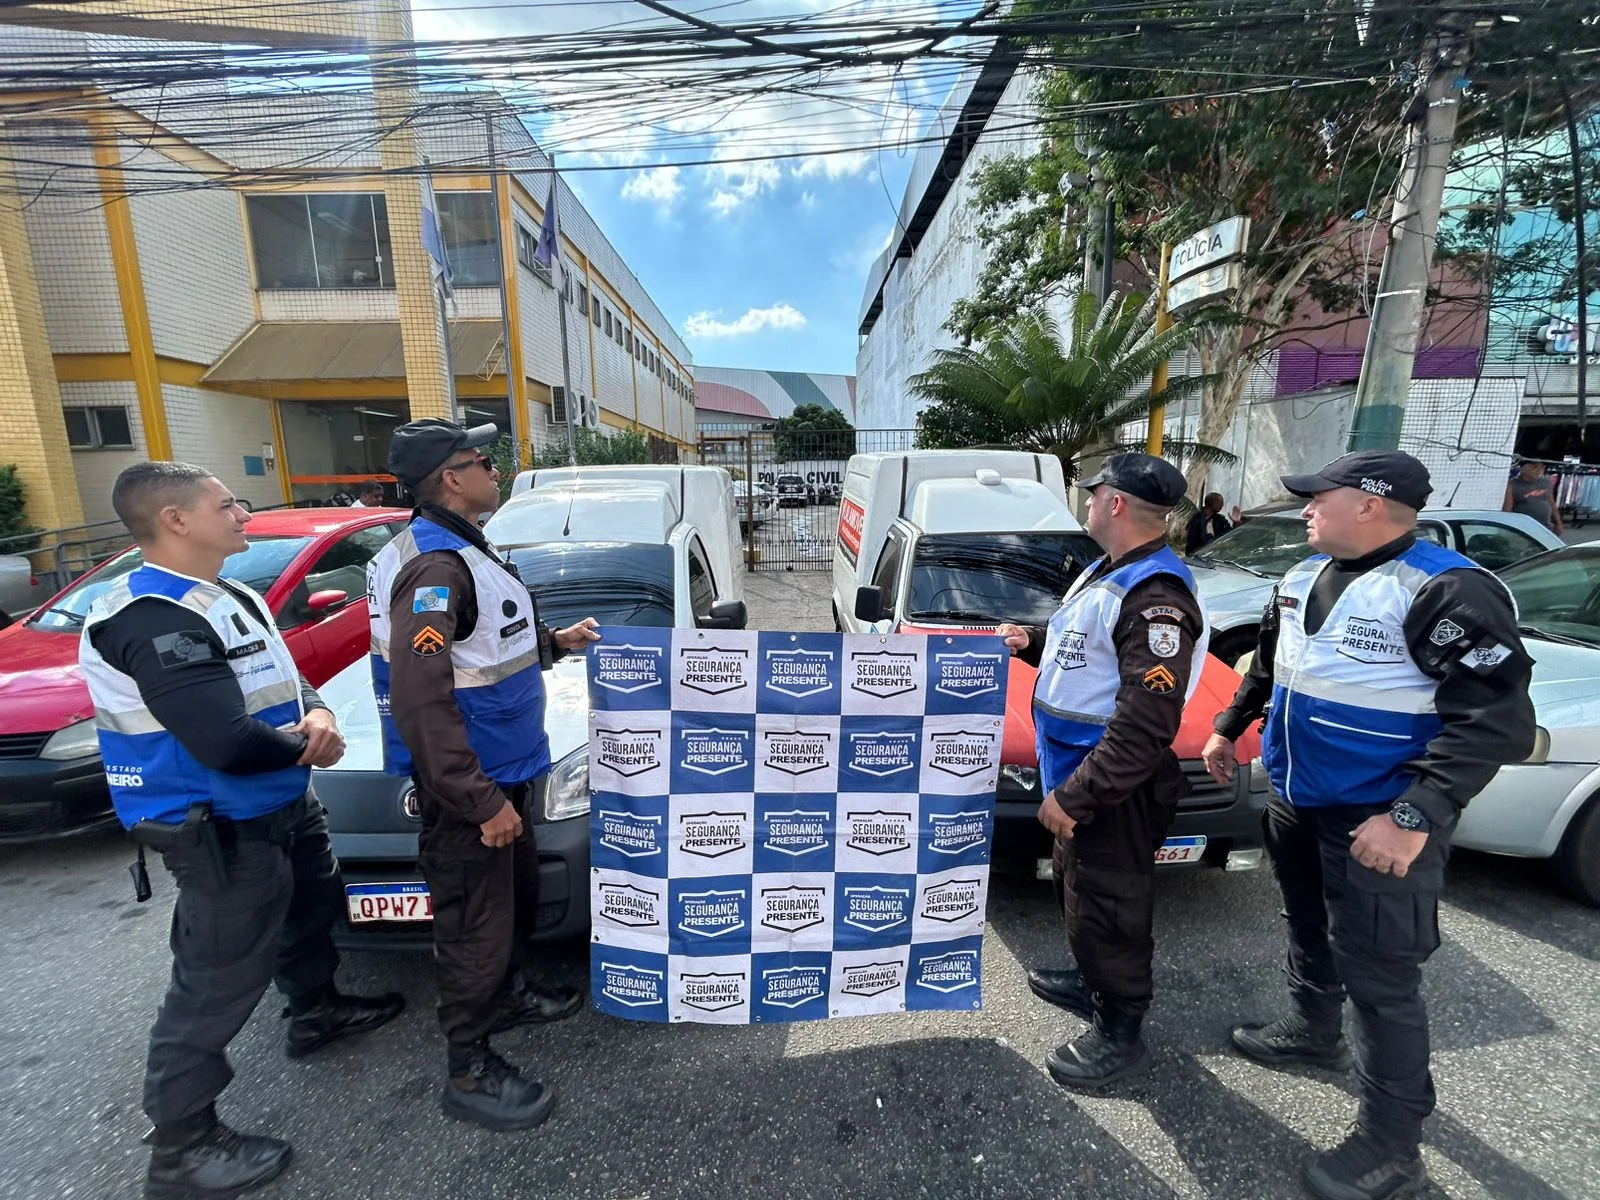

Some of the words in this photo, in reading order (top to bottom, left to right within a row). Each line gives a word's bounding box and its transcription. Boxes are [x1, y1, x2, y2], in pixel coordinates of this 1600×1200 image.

[806, 471, 842, 484] CIVIL
[1360, 477, 1392, 491] POLÍCIA
[1360, 483, 1386, 496] PENAL
[506, 624, 521, 634] COSTA
[1342, 636, 1404, 656] PRESENTE
[600, 658, 656, 672] SEGURANÇA
[686, 661, 742, 675] SEGURANÇA
[772, 663, 827, 677] SEGURANÇA
[857, 665, 912, 679] SEGURANÇA
[600, 672, 656, 681] PRESENTE
[686, 674, 742, 684] PRESENTE
[941, 666, 994, 680] SEGURANÇA
[772, 676, 827, 685] PRESENTE
[857, 678, 912, 686] PRESENTE
[941, 678, 994, 687] PRESENTE
[602, 741, 655, 756] SEGURANÇA
[688, 742, 742, 756] SEGURANÇA
[770, 743, 824, 758] SEGURANÇA
[856, 744, 908, 758] SEGURANÇA
[936, 744, 988, 758] SEGURANÇA
[603, 754, 655, 765] PRESENTE
[687, 755, 742, 763] PRESENTE
[770, 756, 824, 764] PRESENTE
[855, 757, 908, 765] PRESENTE
[935, 756, 987, 766] PRESENTE
[106, 772, 144, 787] NEIRO
[604, 823, 655, 841] SEGURANÇA
[686, 825, 740, 840] SEGURANÇA
[770, 823, 823, 837] SEGURANÇA
[852, 823, 906, 837] SEGURANÇA
[935, 822, 983, 838] SEGURANÇA
[605, 834, 655, 850] PRESENTE
[686, 838, 740, 847] PRESENTE
[770, 836, 823, 844] PRESENTE
[852, 836, 906, 845] PRESENTE
[934, 834, 983, 847] PRESENTE
[1155, 848, 1190, 860] G61
[604, 894, 654, 913] SEGURANÇA
[927, 891, 974, 906] SEGURANÇA
[684, 903, 739, 917] SEGURANÇA
[766, 899, 819, 913] SEGURANÇA
[850, 900, 903, 914] SEGURANÇA
[926, 902, 974, 913] PRESENTE
[605, 906, 654, 921] PRESENTE
[766, 912, 819, 921] PRESENTE
[850, 912, 902, 920] PRESENTE
[684, 916, 739, 926] PRESENTE
[923, 961, 971, 974] SEGURANÇA
[606, 975, 657, 993] SEGURANÇA
[768, 976, 819, 991] SEGURANÇA
[848, 970, 896, 984] SEGURANÇA
[922, 973, 971, 981] PRESENTE
[686, 984, 739, 996] SEGURANÇA
[846, 979, 896, 990] PRESENTE
[606, 986, 657, 1000] PRESENTE
[768, 988, 819, 999] PRESENTE
